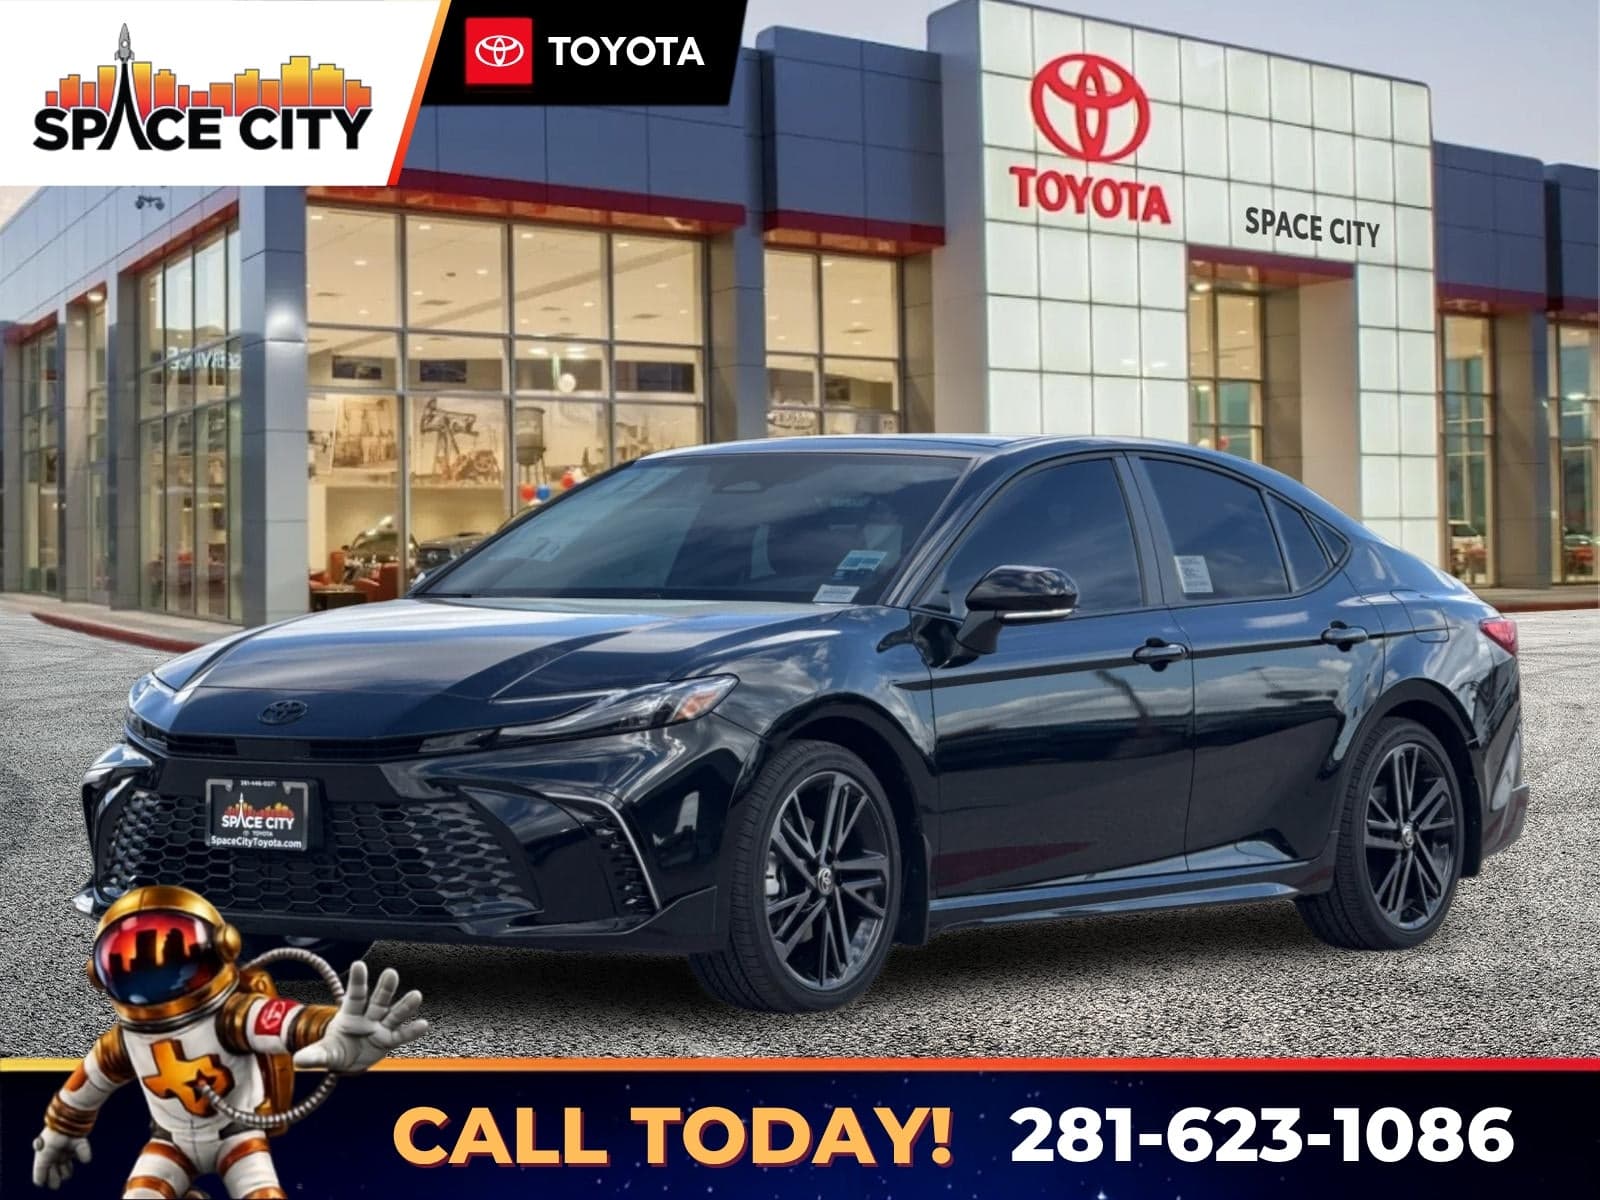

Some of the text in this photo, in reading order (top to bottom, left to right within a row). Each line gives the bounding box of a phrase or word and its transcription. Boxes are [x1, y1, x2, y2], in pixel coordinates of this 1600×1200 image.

[1009, 166, 1172, 225] TOYOTA
[1245, 206, 1381, 248] SPACE CITY
[221, 815, 294, 830] SPACE CITY
[211, 835, 302, 848] SpaceCityToyota.com
